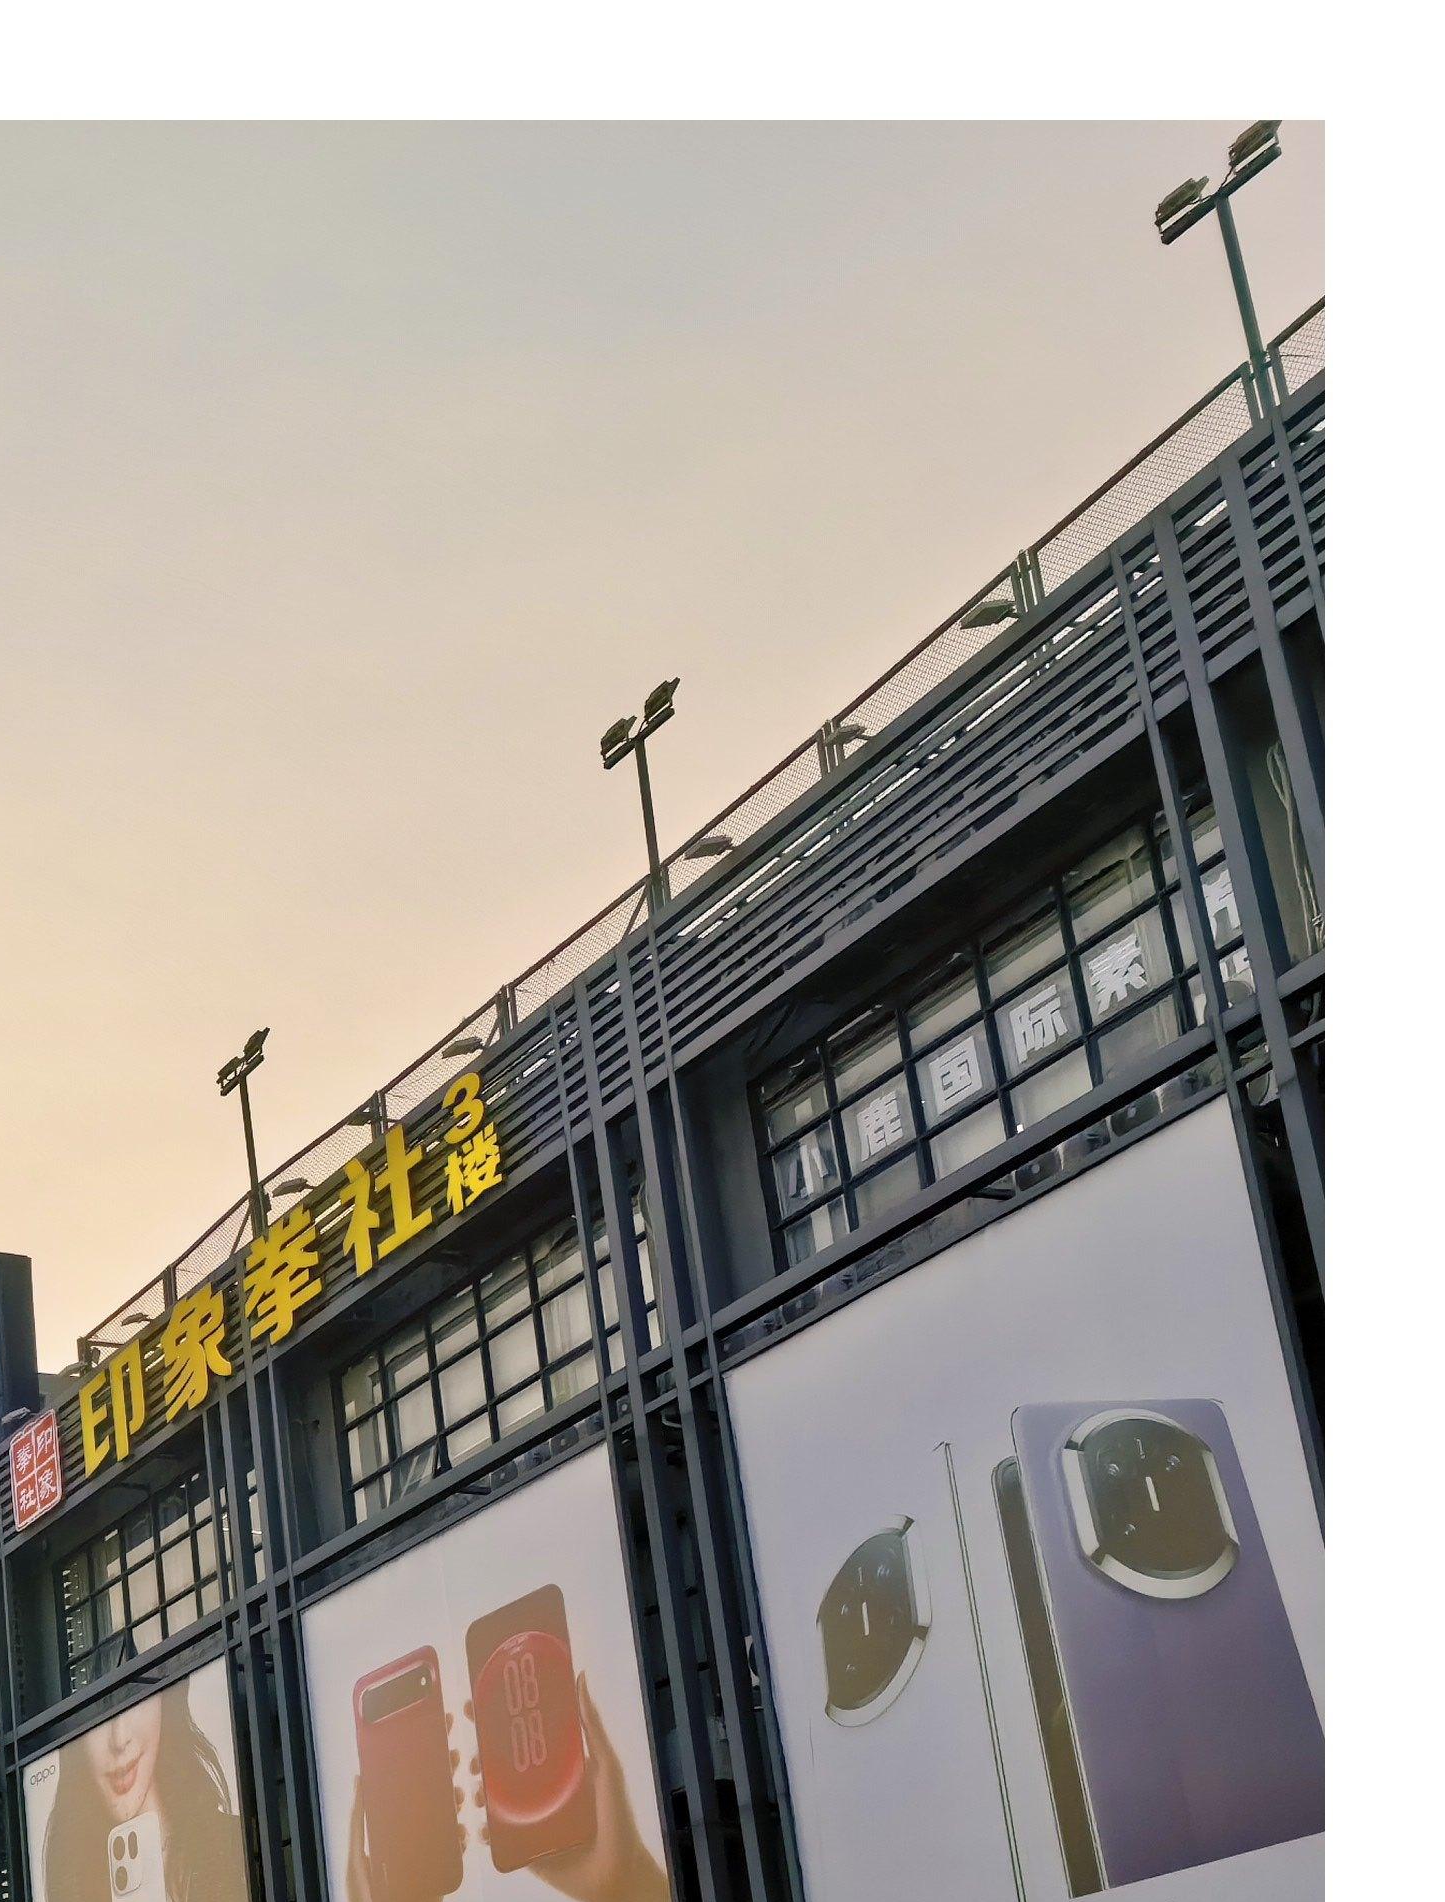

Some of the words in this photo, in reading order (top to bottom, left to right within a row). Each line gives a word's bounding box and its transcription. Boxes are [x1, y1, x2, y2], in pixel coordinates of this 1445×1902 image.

[79, 1124, 432, 1478] 印象拳社
[29, 1764, 56, 1787] oppo
